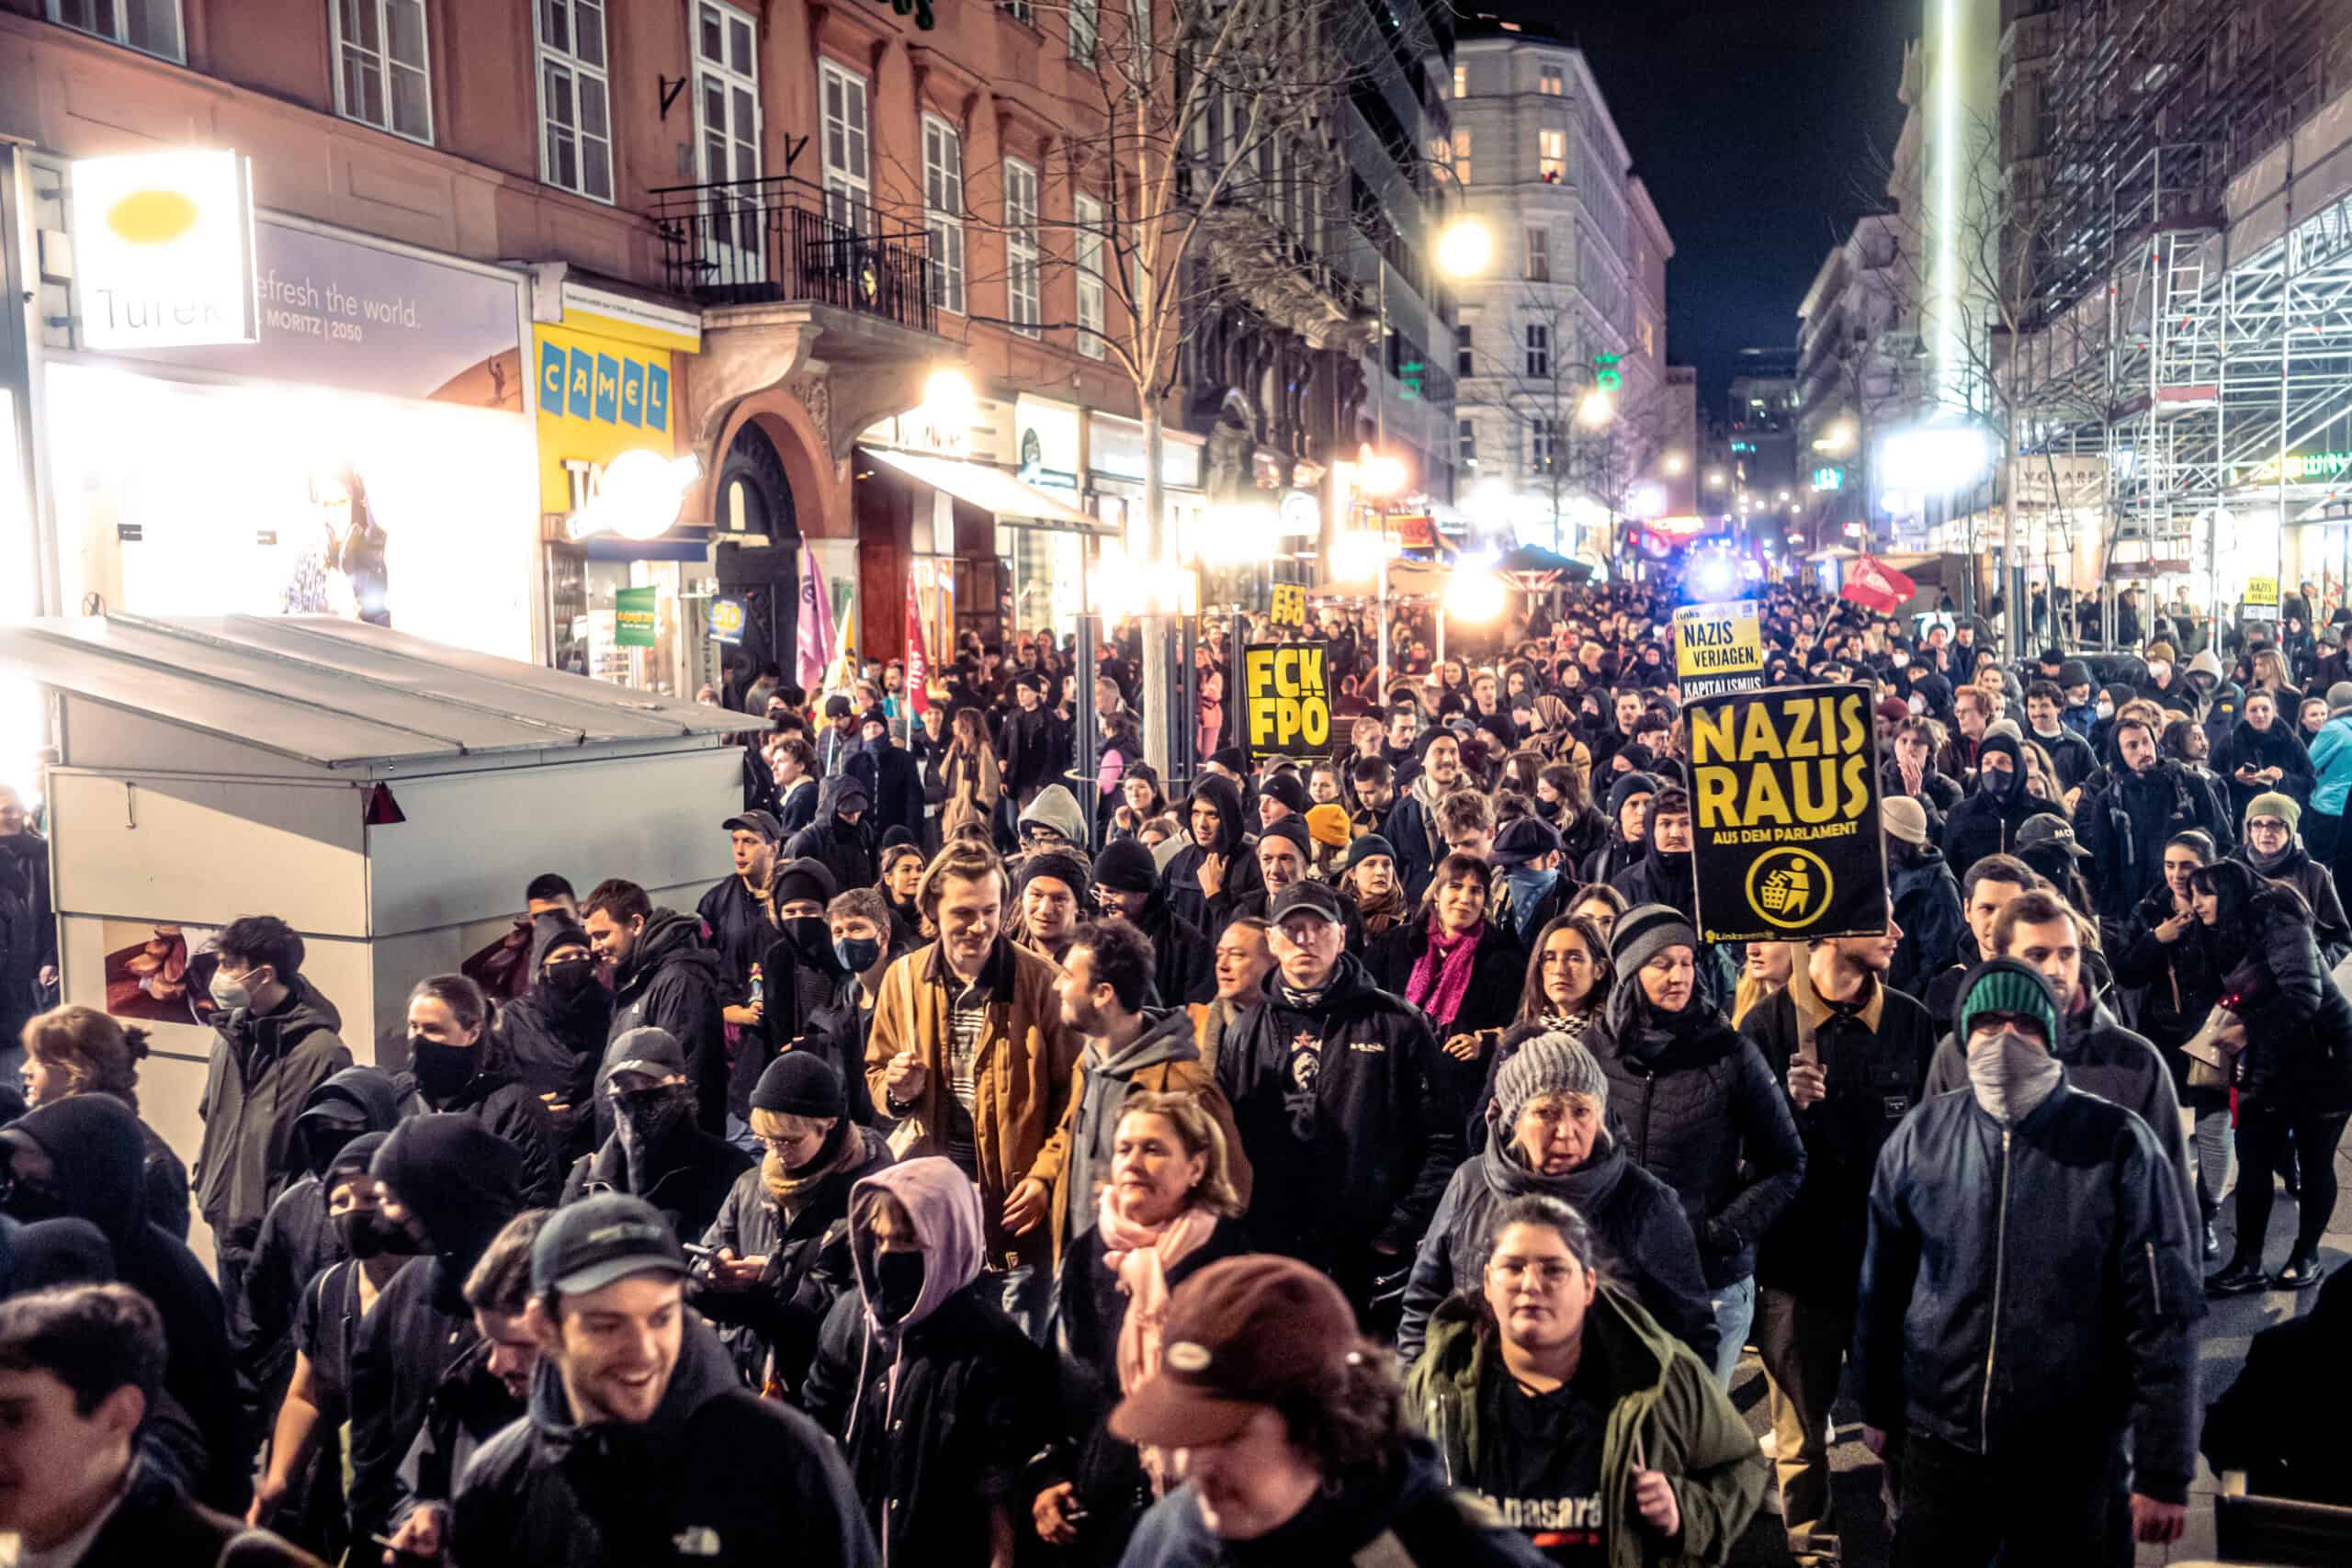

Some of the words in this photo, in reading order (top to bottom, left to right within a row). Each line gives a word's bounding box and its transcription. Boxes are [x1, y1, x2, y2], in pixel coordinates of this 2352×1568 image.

[257, 268, 319, 310] efresh
[324, 283, 357, 316] the
[362, 295, 424, 330] world.
[266, 308, 322, 336] MORITZ
[331, 320, 363, 343] 2050
[544, 363, 662, 408] CAMEL
[1683, 620, 1734, 648] NAZIS
[1246, 648, 1326, 698] FCK
[1693, 646, 1758, 668] VERJAGEN,
[1684, 676, 1761, 698] KAPITALISMUS
[1690, 693, 1866, 764] NAZIS
[1694, 753, 1870, 829] RAUS
[1713, 829, 1739, 845] AUS
[1741, 829, 1772, 843] DEM
[1776, 820, 1858, 841] PARLAMENT
